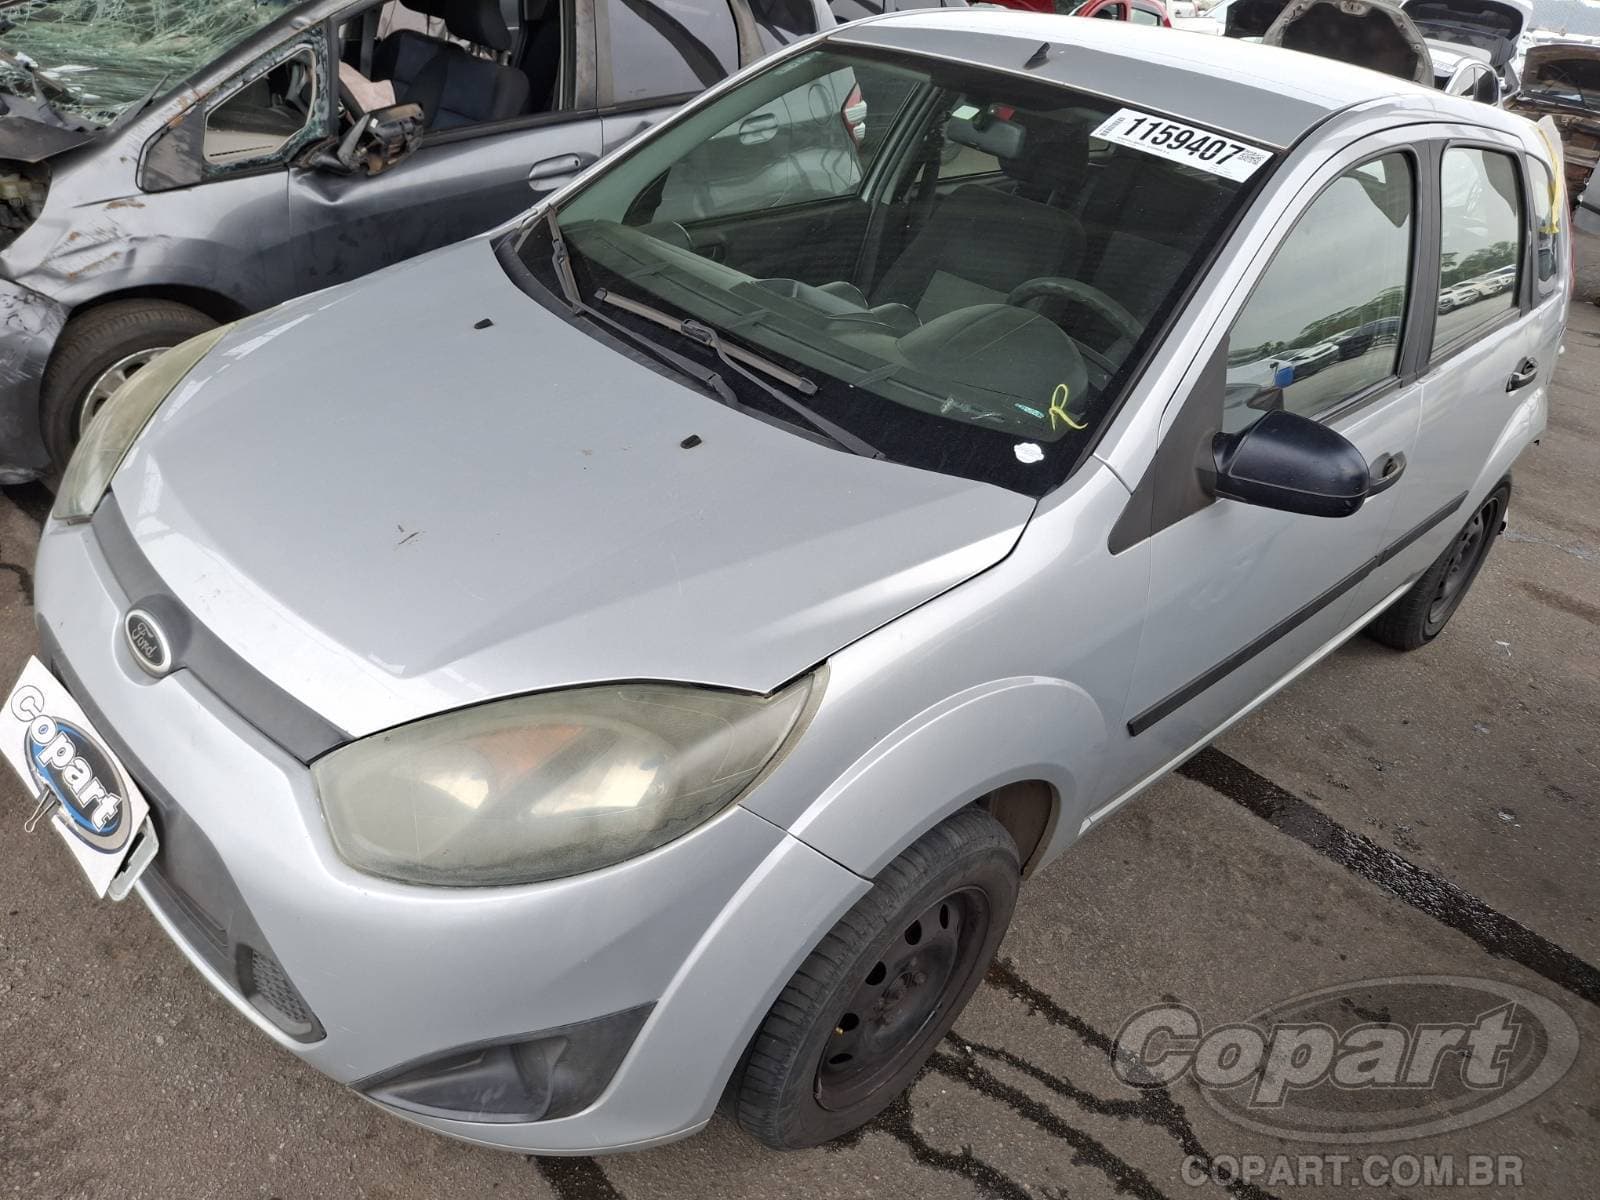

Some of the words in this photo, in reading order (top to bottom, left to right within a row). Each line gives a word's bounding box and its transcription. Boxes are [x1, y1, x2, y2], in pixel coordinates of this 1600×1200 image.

[1123, 117, 1246, 165] 1159407
[1049, 384, 1088, 431] R
[132, 622, 157, 658] Ford
[11, 685, 122, 832] Copart
